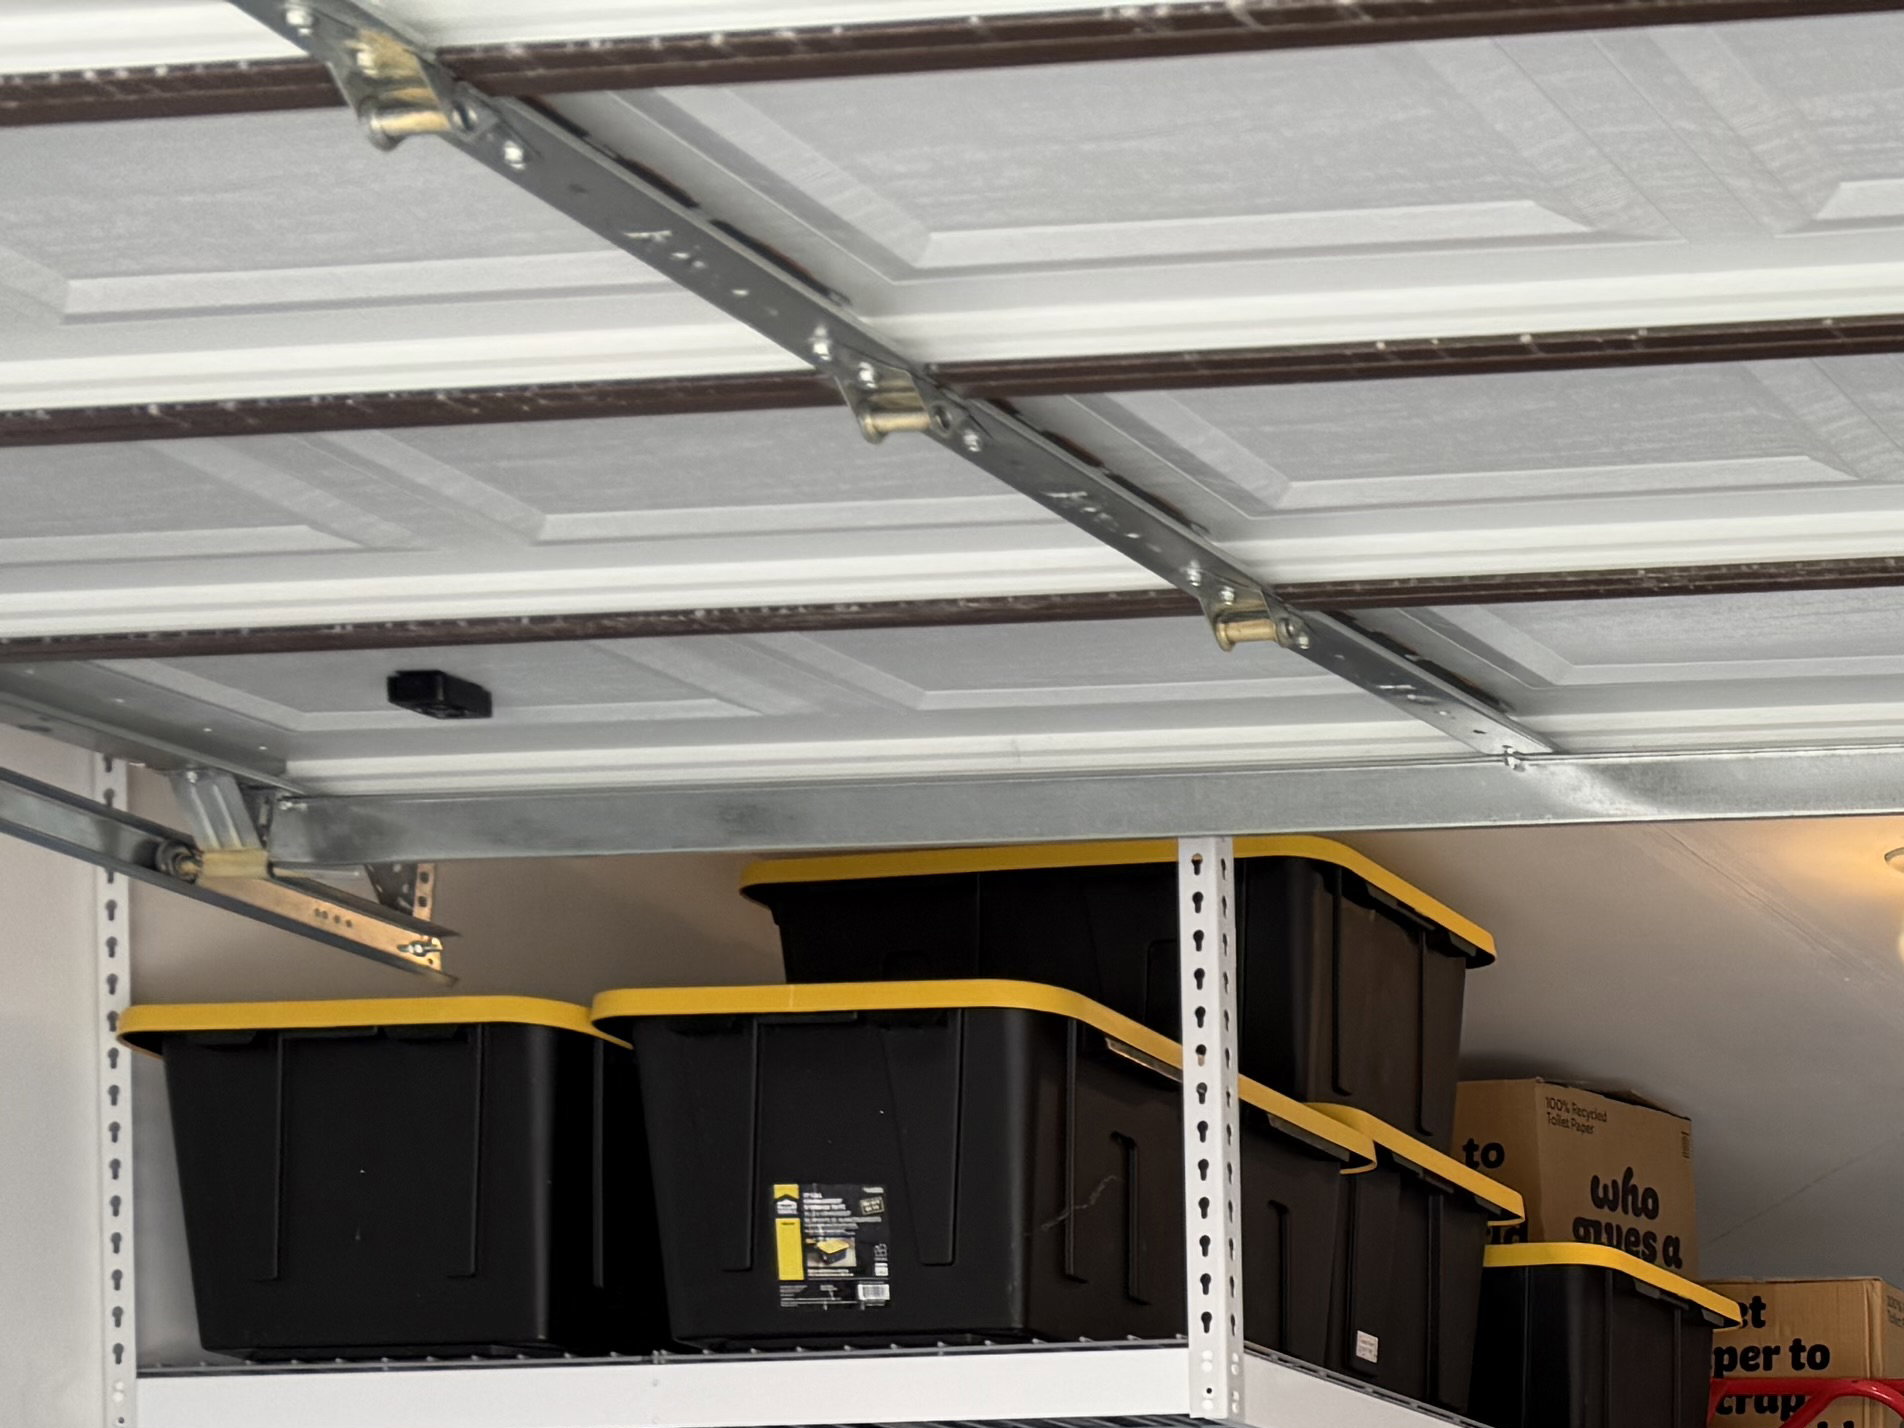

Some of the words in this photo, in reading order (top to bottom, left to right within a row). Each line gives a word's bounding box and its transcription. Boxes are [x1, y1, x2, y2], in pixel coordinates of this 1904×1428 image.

[1545, 1096, 1570, 1114] 100%
[1571, 1101, 1608, 1123] Recycled
[1546, 1112, 1570, 1129] Toilet
[1571, 1118, 1595, 1135] Paper
[1462, 1138, 1505, 1170] to
[1590, 1166, 1660, 1220] who
[1662, 1235, 1684, 1270] a
[1711, 1342, 1781, 1378] per
[1789, 1338, 1831, 1371] to
